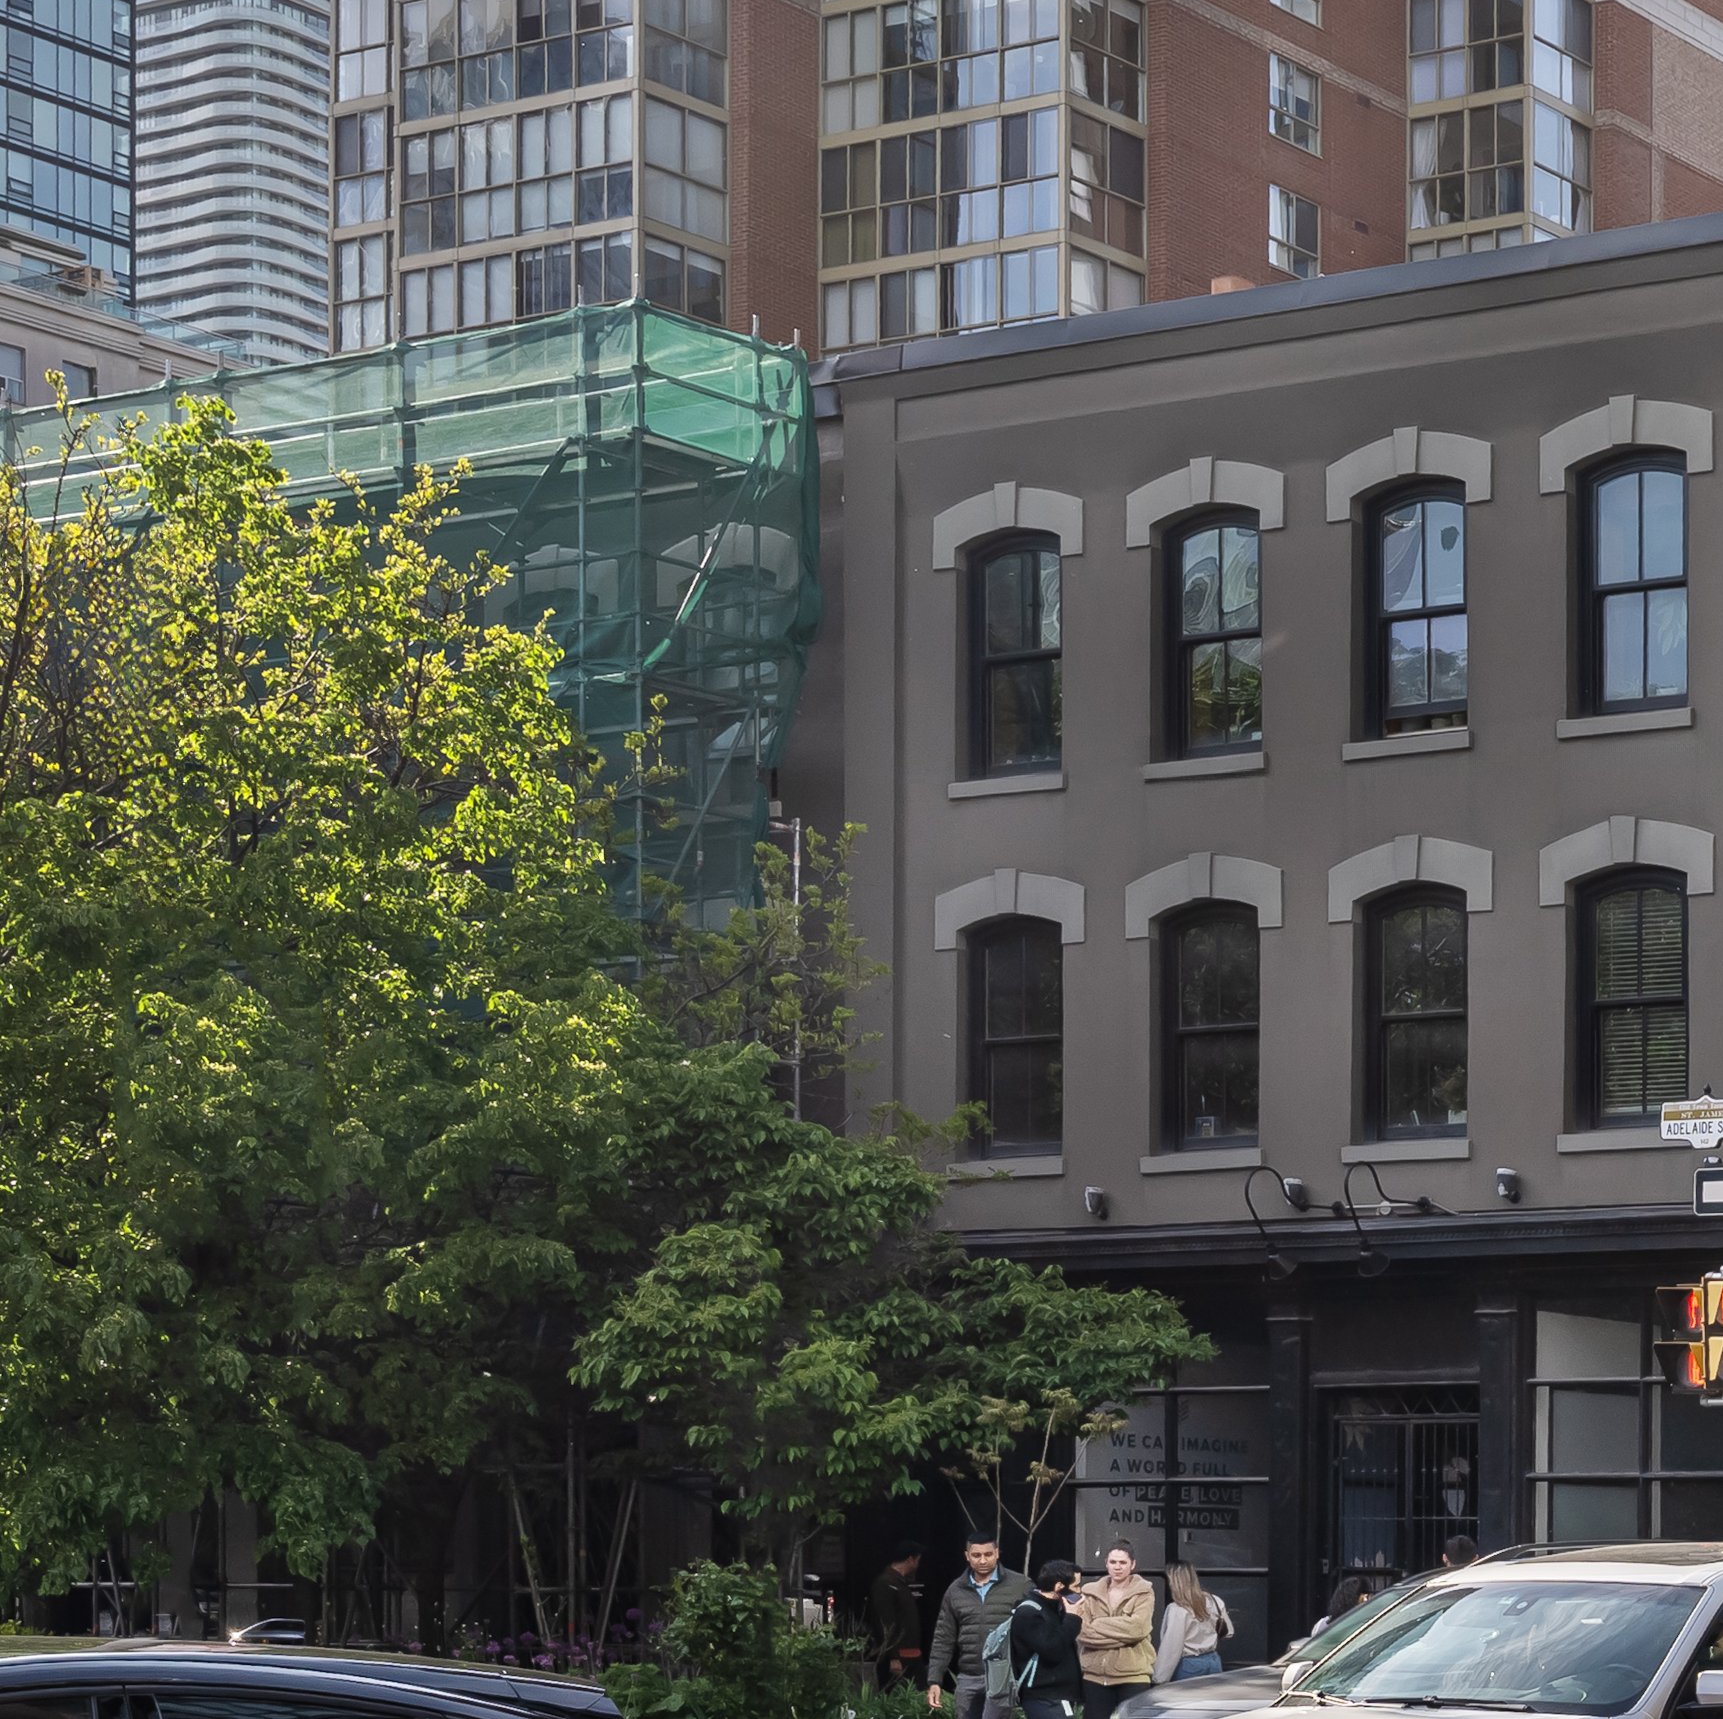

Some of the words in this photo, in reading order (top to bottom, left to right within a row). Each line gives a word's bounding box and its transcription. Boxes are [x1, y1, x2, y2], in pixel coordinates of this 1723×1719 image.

[1681, 1111, 1695, 1119] ST.
[1666, 1121, 1713, 1135] ADELAIDE
[1111, 1434, 1137, 1448] WE
[1142, 1435, 1164, 1448] CA
[1181, 1437, 1249, 1453] IMAGINE
[1110, 1458, 1121, 1472] A
[1127, 1459, 1187, 1475] WORD
[1193, 1462, 1230, 1477] FULL
[1109, 1485, 1131, 1497] OF
[1136, 1485, 1193, 1502] PEAE,
[1200, 1486, 1241, 1502] LOVE
[1110, 1508, 1145, 1523] AND
[1151, 1510, 1233, 1526] HRMONY
